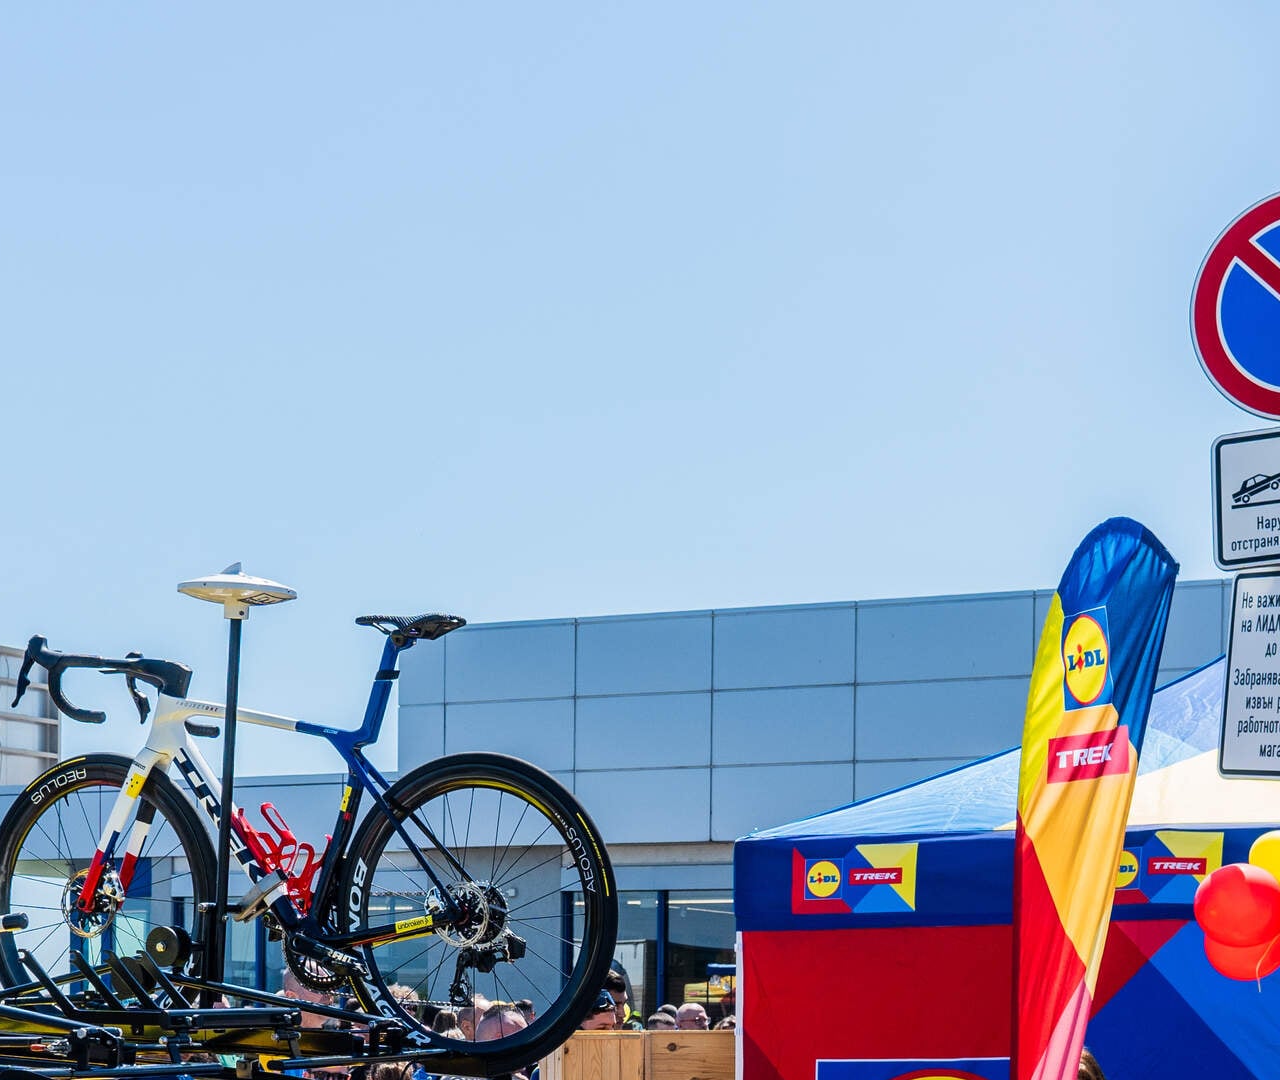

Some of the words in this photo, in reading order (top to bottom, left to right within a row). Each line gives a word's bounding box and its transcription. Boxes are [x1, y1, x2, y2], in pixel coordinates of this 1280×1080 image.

[1242, 592, 1253, 609] Не
[1257, 594, 1280, 608] важи
[1241, 620, 1251, 632] на
[1256, 614, 1280, 634] ЛИДЛ
[1265, 643, 1277, 658] до
[1246, 697, 1273, 710] извън
[1056, 741, 1113, 768] TREK
[31, 768, 86, 805] AEOLUS
[566, 827, 596, 893] AEOLUS
[1153, 862, 1201, 870] TREK
[853, 871, 898, 881] TREK
